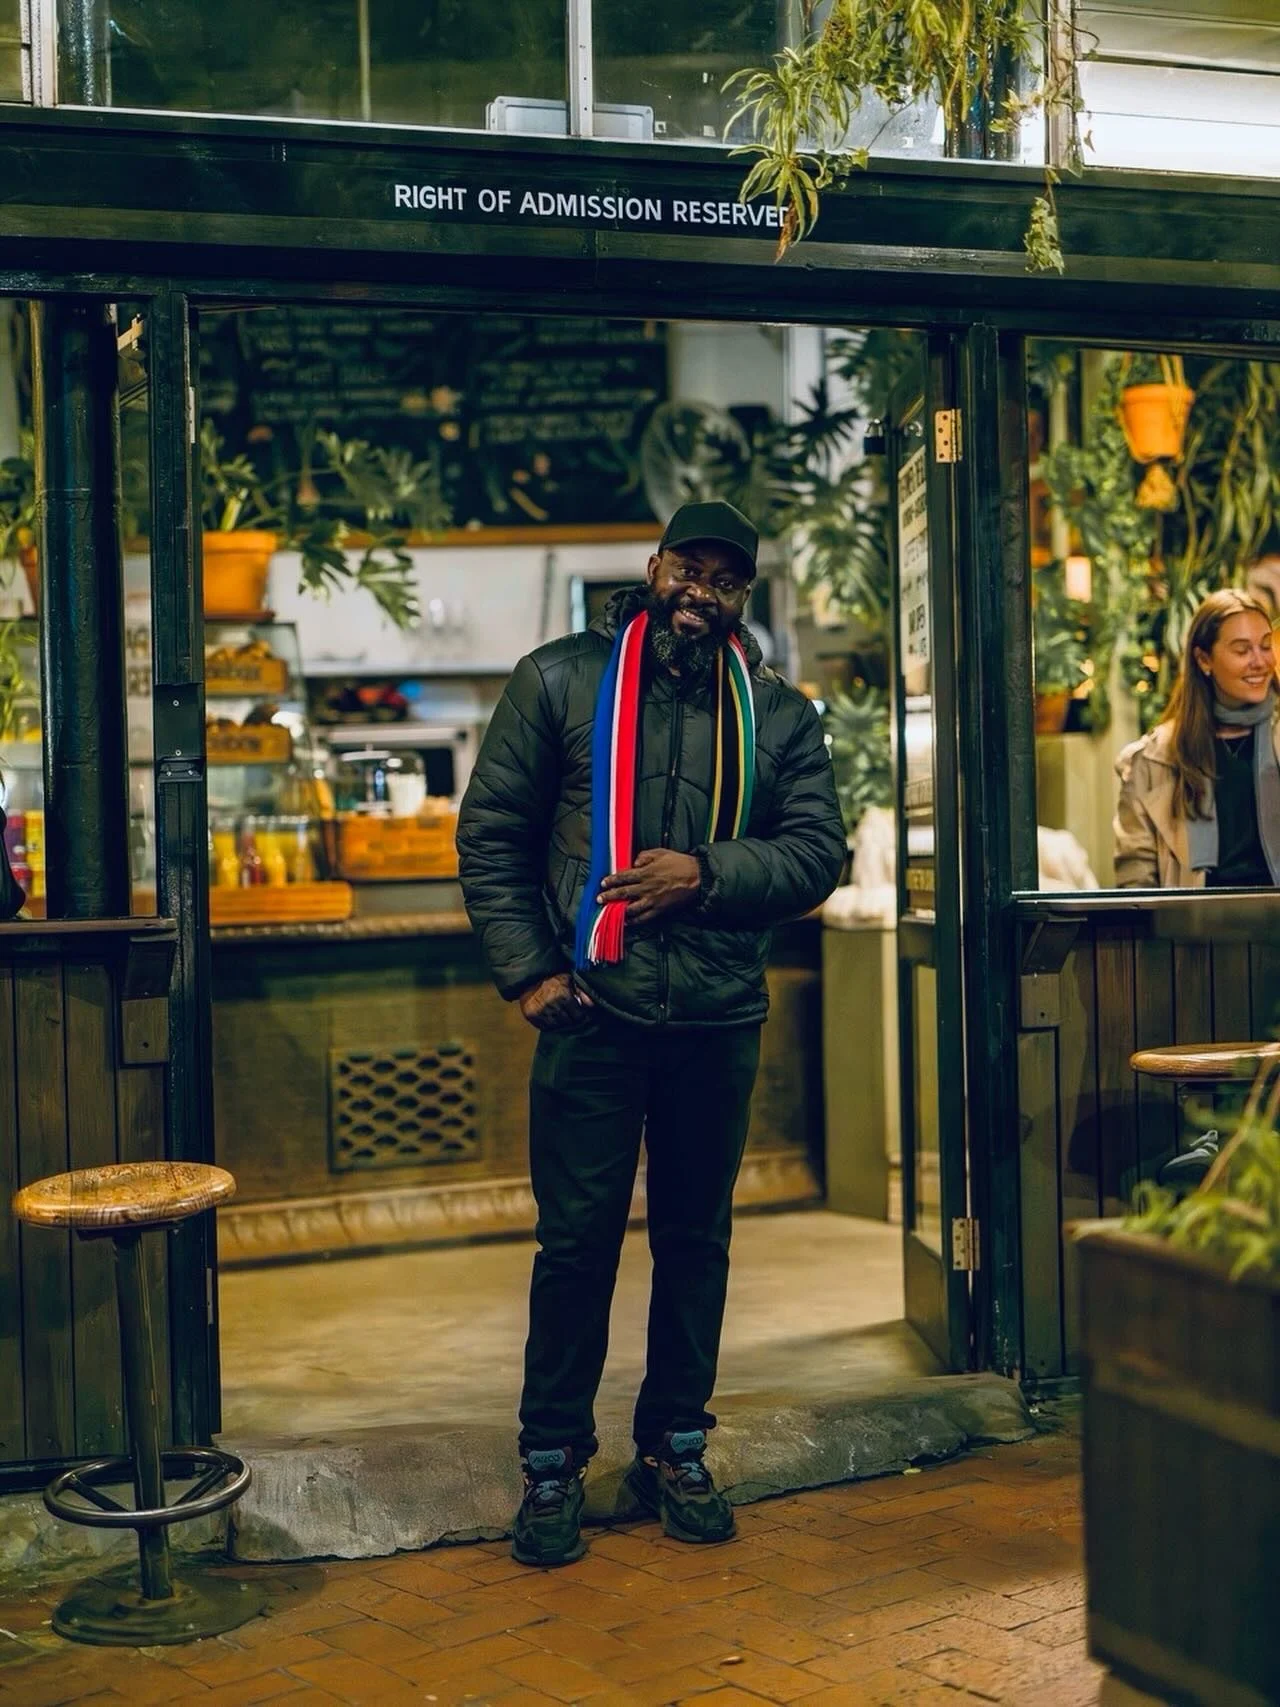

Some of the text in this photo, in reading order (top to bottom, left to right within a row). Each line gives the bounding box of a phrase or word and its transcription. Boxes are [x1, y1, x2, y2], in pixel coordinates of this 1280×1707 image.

[394, 184, 467, 210] RIGHT
[478, 189, 511, 213] OF
[519, 191, 662, 221] ADMISSION
